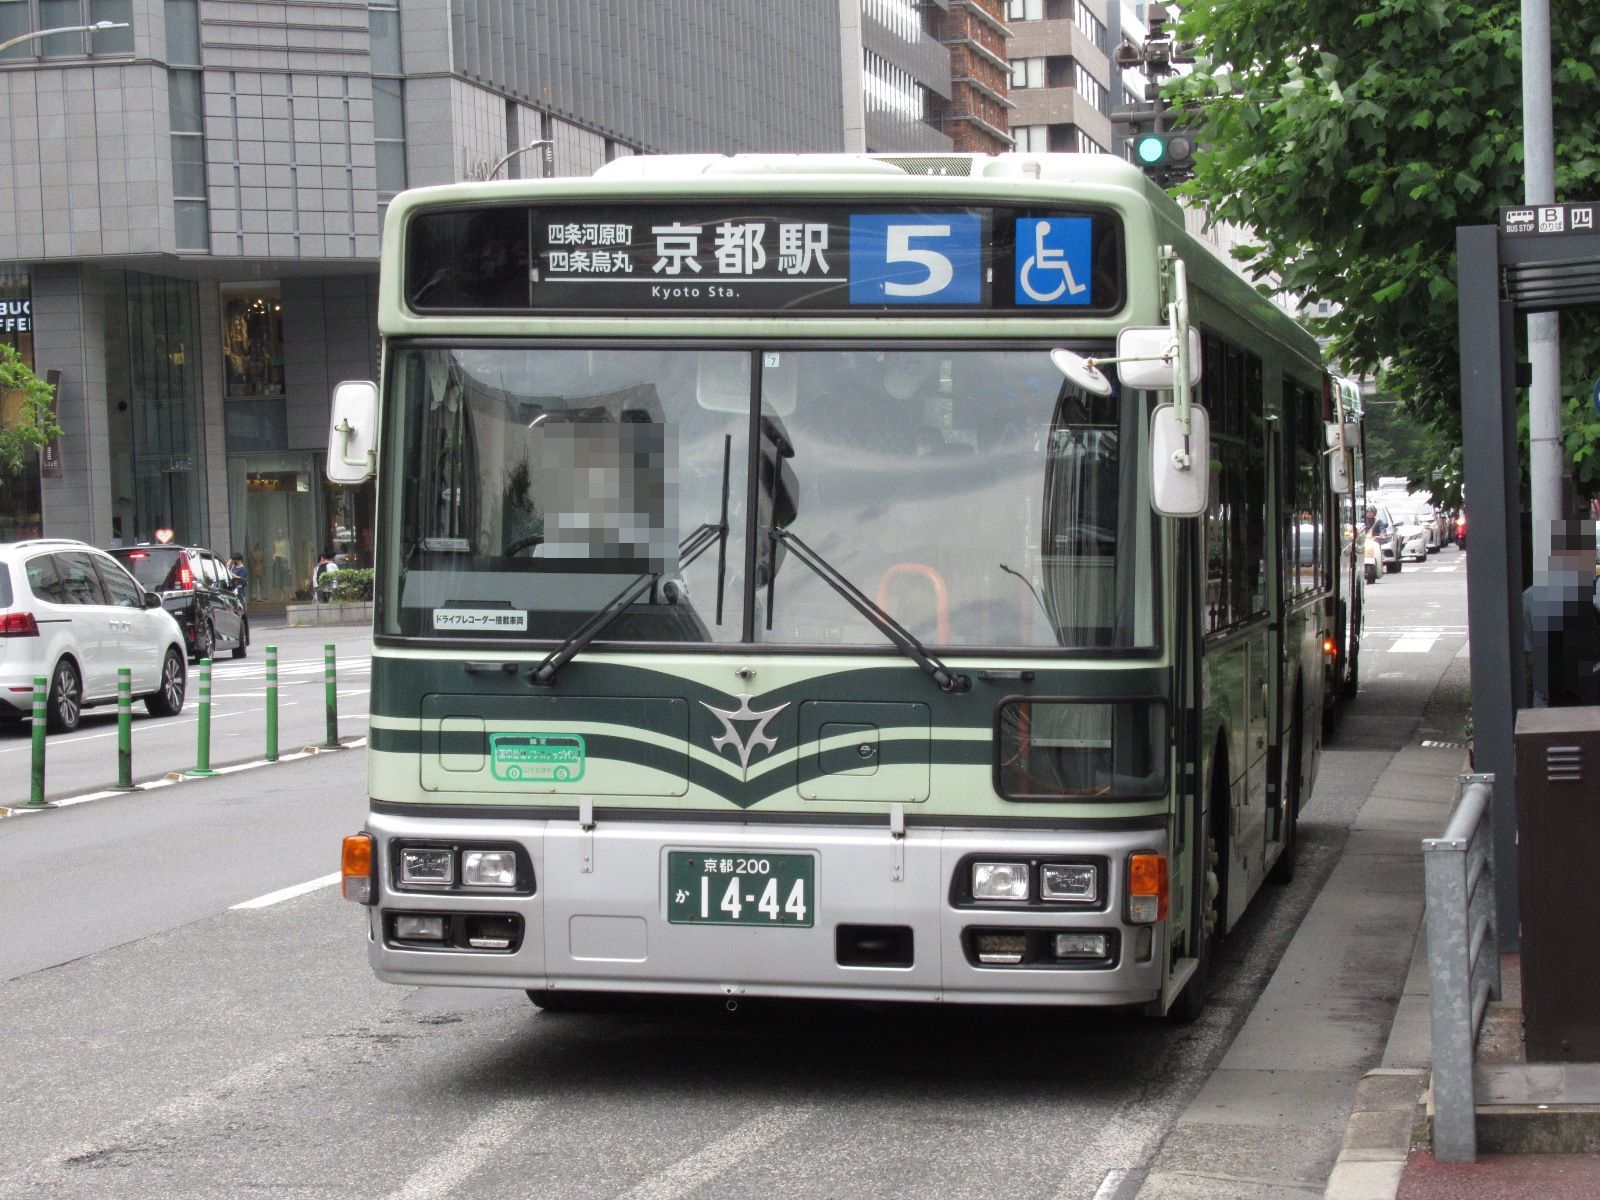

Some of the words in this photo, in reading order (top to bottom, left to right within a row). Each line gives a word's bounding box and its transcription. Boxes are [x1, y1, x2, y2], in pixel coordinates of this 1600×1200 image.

[1545, 208, 1557, 222] B
[1571, 208, 1593, 230] 四
[548, 224, 633, 246] 四条河原町
[1506, 224, 1518, 233] BUS
[1518, 223, 1535, 232] STOP
[1540, 221, 1562, 232] のりば
[651, 222, 830, 275] 京都駅
[549, 251, 633, 273] 四条烏丸
[884, 224, 954, 298] 5
[652, 286, 700, 300] Kyoto
[708, 286, 741, 299] Sta.
[436, 615, 524, 625] ドライブレコーダー搭載車両
[675, 889, 690, 904] か
[701, 876, 807, 921] 14-44
